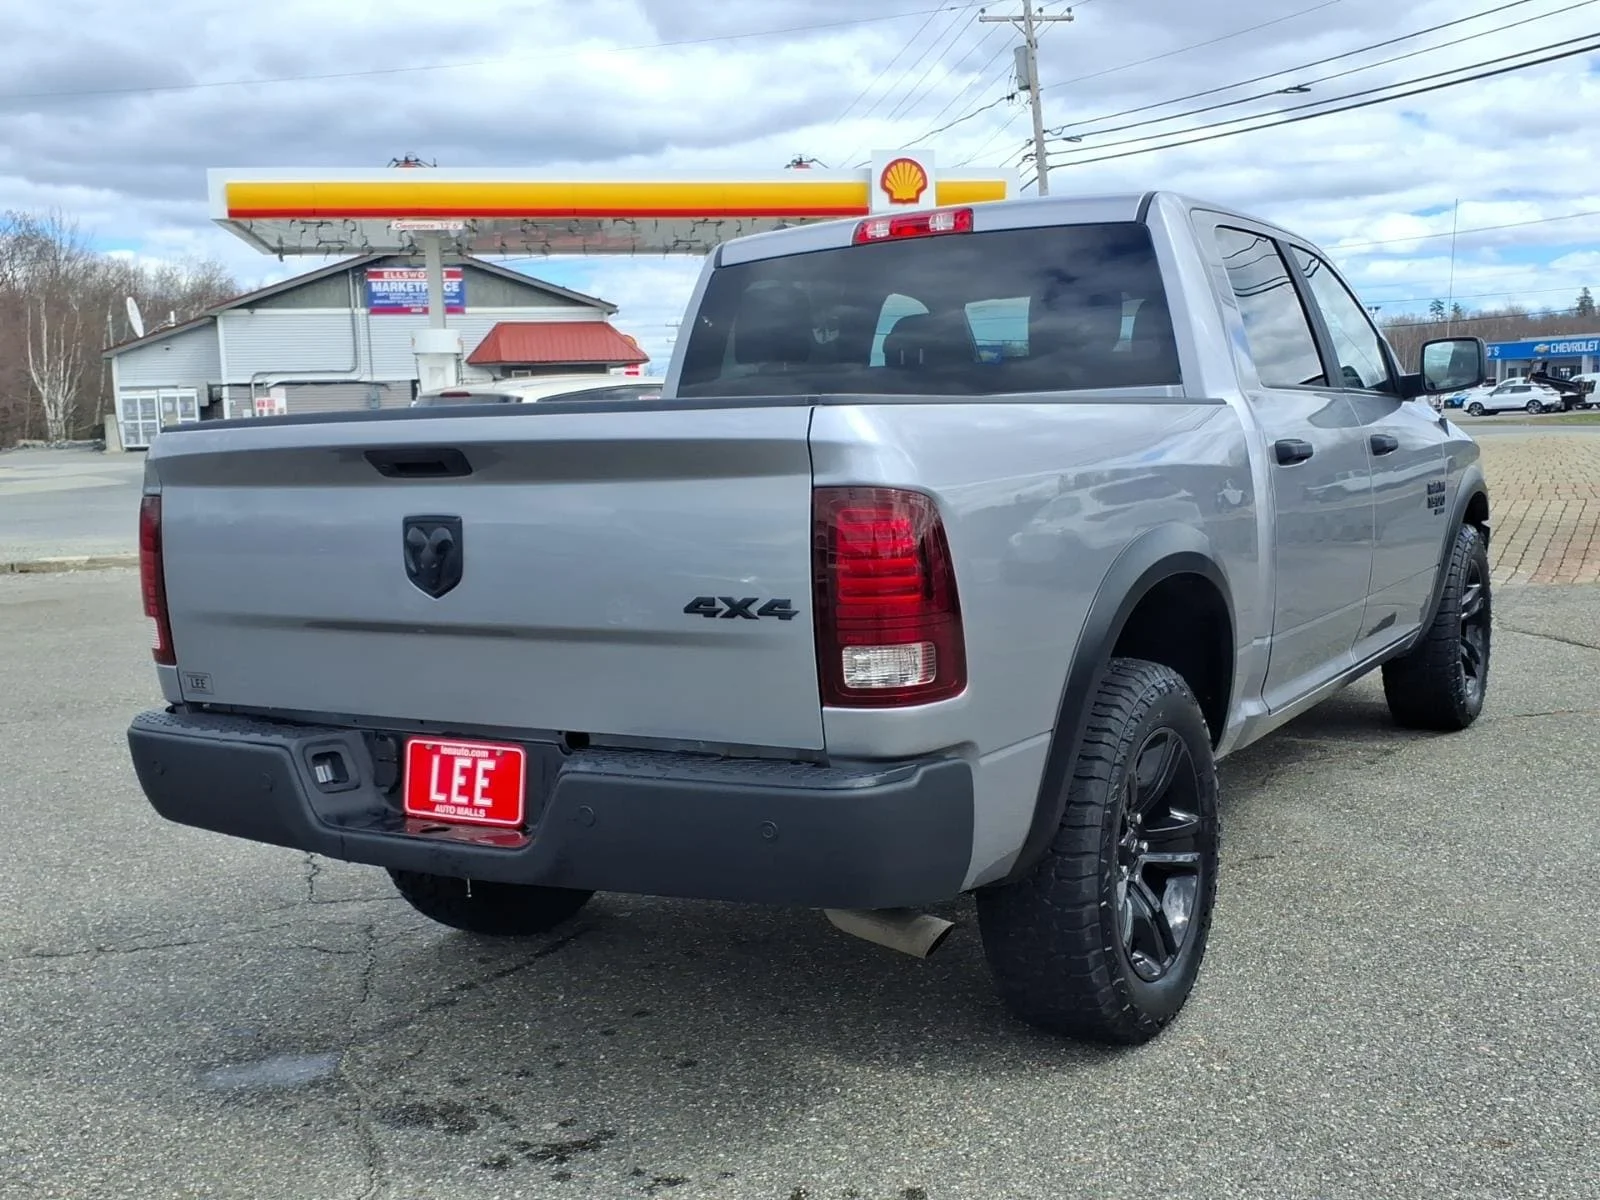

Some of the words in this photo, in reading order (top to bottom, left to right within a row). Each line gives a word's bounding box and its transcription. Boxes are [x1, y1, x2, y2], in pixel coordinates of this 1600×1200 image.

[371, 282, 460, 292] MARKETPCE
[1550, 341, 1598, 353] CHEVROLET
[191, 678, 206, 689] LEE
[441, 745, 489, 758] leeauto.com
[430, 755, 496, 807] LEE
[434, 804, 456, 814] AUTO
[457, 806, 486, 818] MALLS
